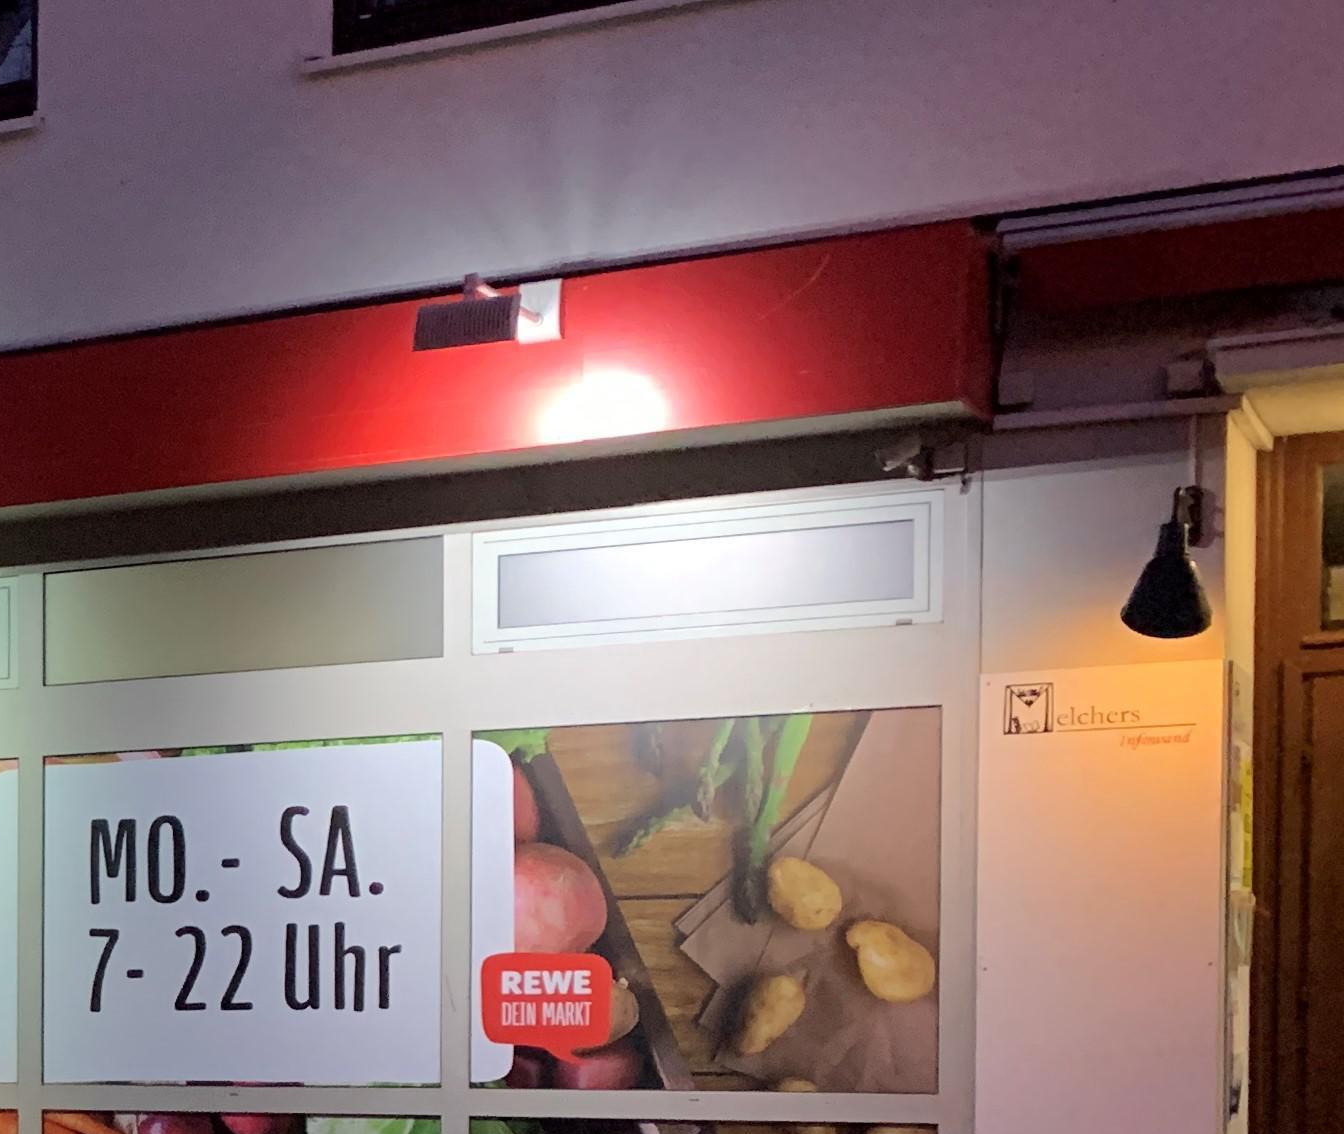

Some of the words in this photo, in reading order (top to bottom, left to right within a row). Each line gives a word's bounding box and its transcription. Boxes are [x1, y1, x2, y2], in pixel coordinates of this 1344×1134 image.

[277, 805, 384, 899] SA.
[174, 925, 253, 1011] 22
[284, 922, 402, 1012] Uhr
[501, 970, 593, 995] REWE
[501, 1001, 537, 1026] DEIN
[542, 1001, 592, 1026] MARKT
